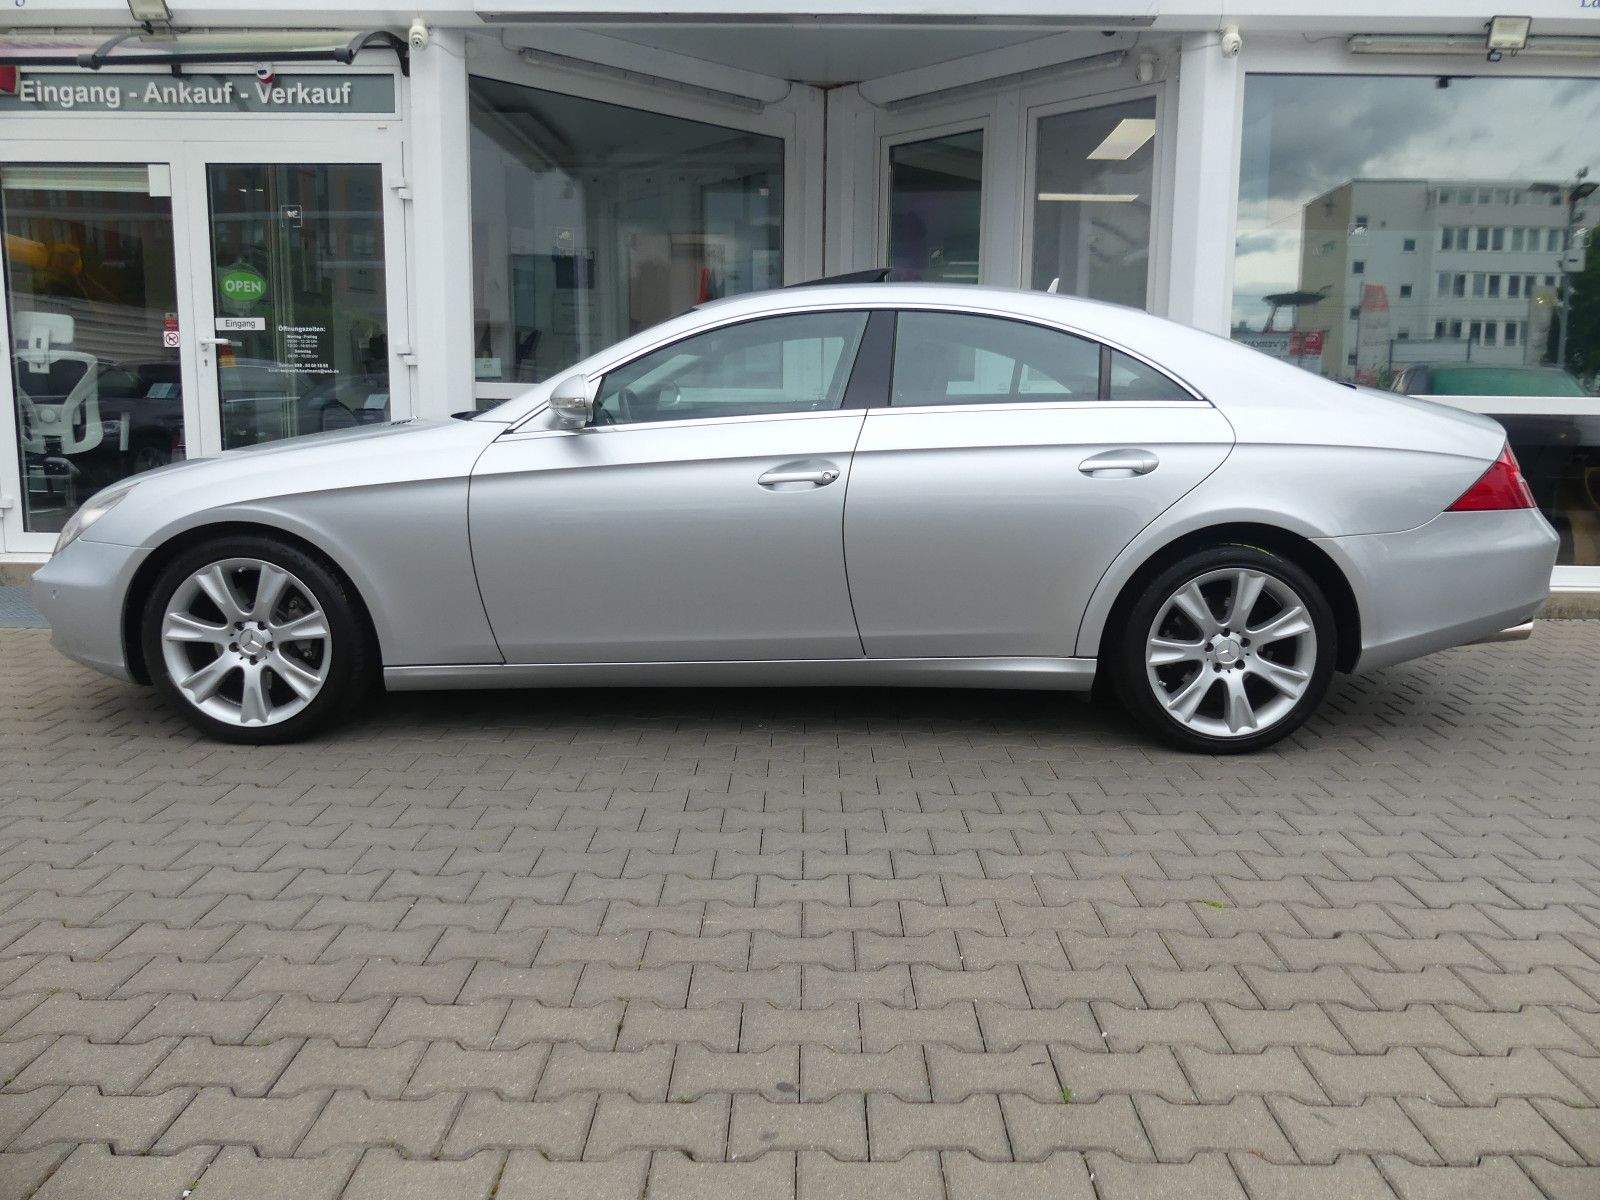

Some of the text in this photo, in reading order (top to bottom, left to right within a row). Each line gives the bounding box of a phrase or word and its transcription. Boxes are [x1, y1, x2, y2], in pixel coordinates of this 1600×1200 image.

[20, 80, 120, 109] Eingang
[144, 81, 234, 105] Ankauf
[254, 81, 352, 104] Verkauf
[225, 280, 262, 293] OPEN
[225, 319, 256, 329] Eingang
